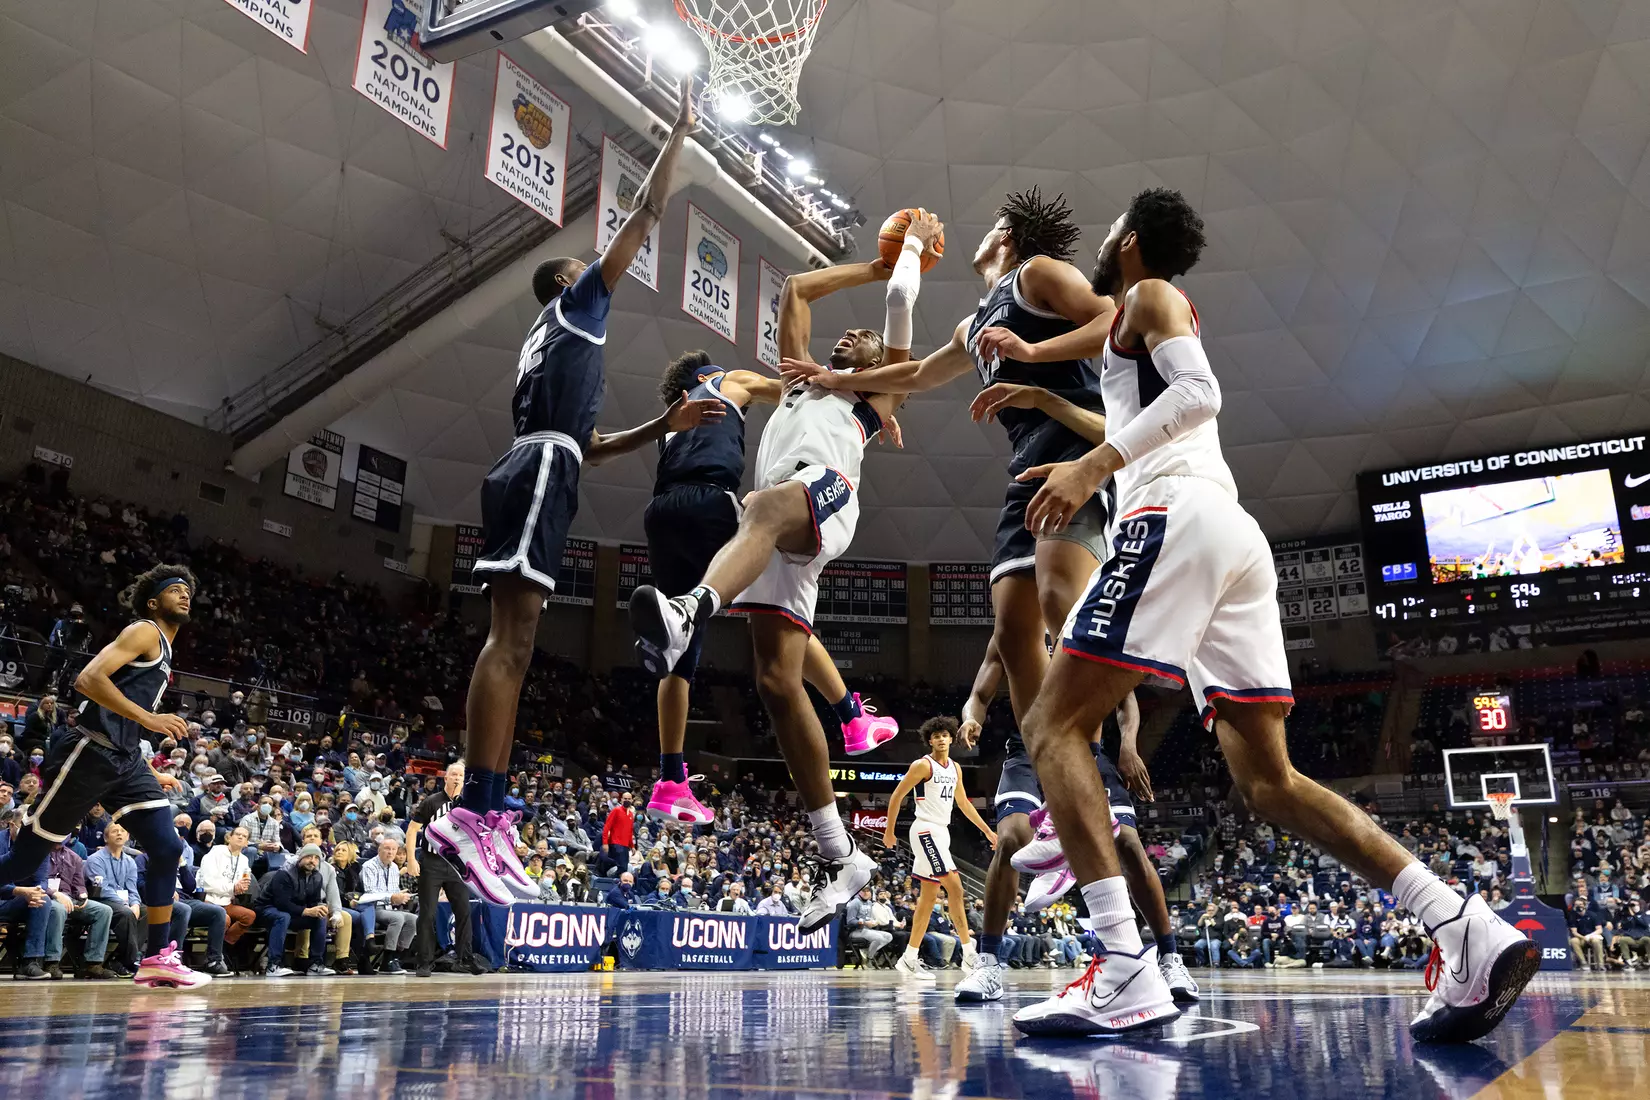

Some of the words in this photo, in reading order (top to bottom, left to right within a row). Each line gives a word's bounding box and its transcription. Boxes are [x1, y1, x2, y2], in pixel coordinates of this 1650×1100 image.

[371, 40, 440, 103] 2010
[373, 70, 434, 119] NATIONAL
[506, 60, 531, 85] UConn
[532, 80, 564, 111] Women's
[515, 80, 554, 114] Basketball
[365, 83, 437, 137] CHAMPIONS
[500, 132, 555, 187] 2013
[609, 142, 631, 162] UConn
[631, 158, 649, 176] Wom
[501, 159, 551, 201] NATIONAL
[495, 171, 554, 217] CHAMPIONS
[693, 207, 711, 231] UConn
[605, 208, 652, 256] 24
[700, 222, 729, 249] Basketball
[690, 269, 731, 311] 2015
[692, 293, 729, 324] NATIONAL
[688, 303, 731, 338] CHAMPIONS
[52, 453, 72, 466] 210
[1382, 458, 1483, 487] UNIVERSITY
[1487, 455, 1513, 471] OF
[1514, 436, 1646, 468] CONNECTICUT
[1372, 500, 1411, 514] WELLS
[1374, 510, 1412, 522] FARGO
[279, 525, 291, 537] 211
[460, 527, 479, 536] BIG
[1087, 519, 1149, 639] HUSKIES
[1278, 566, 1300, 580] 44
[1338, 560, 1361, 574] 42
[1382, 562, 1413, 576] CBS
[1632, 587, 1641, 598] 2
[1284, 602, 1301, 617] 13
[1312, 600, 1333, 614] 22
[1375, 603, 1396, 620] 47
[1430, 608, 1438, 618] 2
[1468, 604, 1476, 614] 2
[268, 708, 285, 718] SEC
[286, 709, 312, 725] 109
[1479, 708, 1507, 730] 30
[352, 732, 362, 740] SE
[541, 763, 556, 775] 110
[859, 771, 875, 780] Real
[874, 772, 896, 781] Estate
[618, 777, 632, 789] 111
[940, 785, 954, 802] 44
[1590, 788, 1611, 799] 116
[1188, 807, 1204, 816] 113
[922, 836, 942, 873] HUSKIES
[504, 911, 606, 948] UCONN
[671, 917, 746, 949] UCONN
[768, 922, 831, 950] UCONN
[681, 953, 734, 964] BASKETBALL
[777, 954, 820, 963] BASKETBALL
